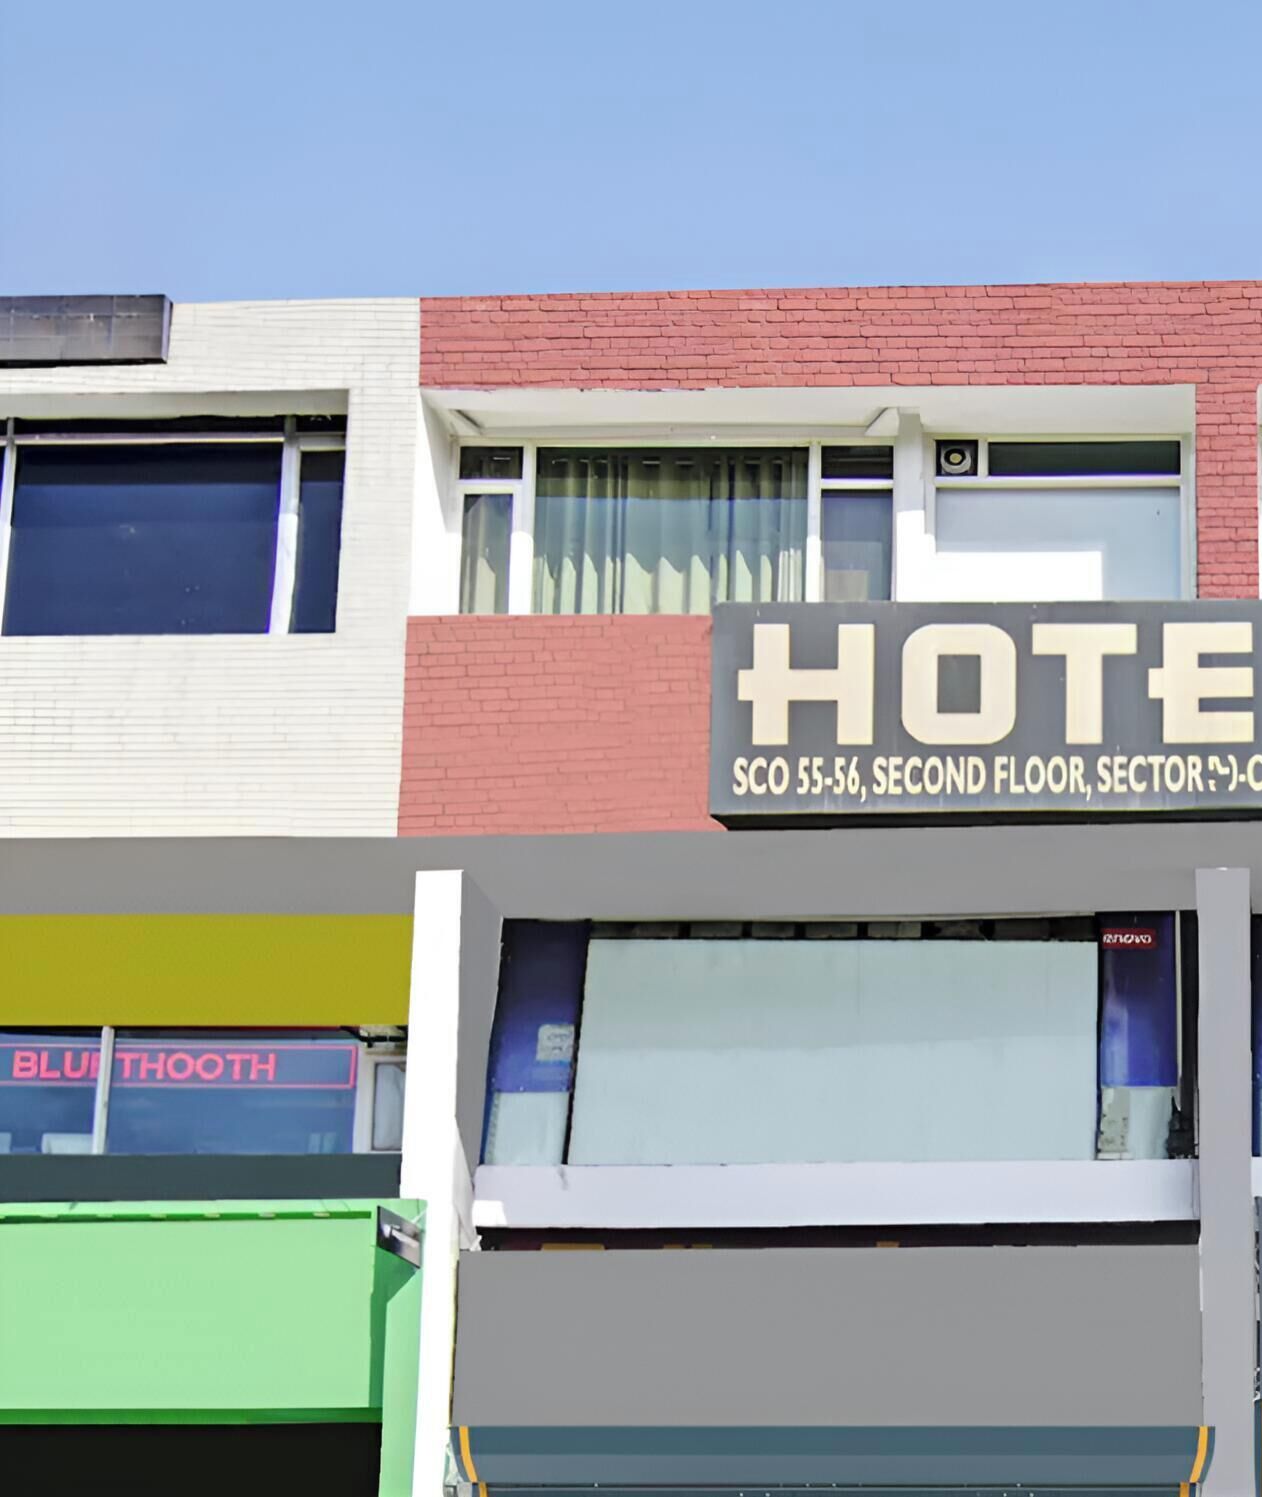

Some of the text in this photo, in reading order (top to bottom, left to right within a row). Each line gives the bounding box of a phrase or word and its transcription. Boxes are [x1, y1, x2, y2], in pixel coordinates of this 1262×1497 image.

[732, 756, 790, 796] SCO
[796, 756, 867, 802] 55-56,
[872, 756, 987, 796] SECOND
[993, 755, 1092, 802] FLOOR,
[1097, 754, 1204, 794] SECTOR
